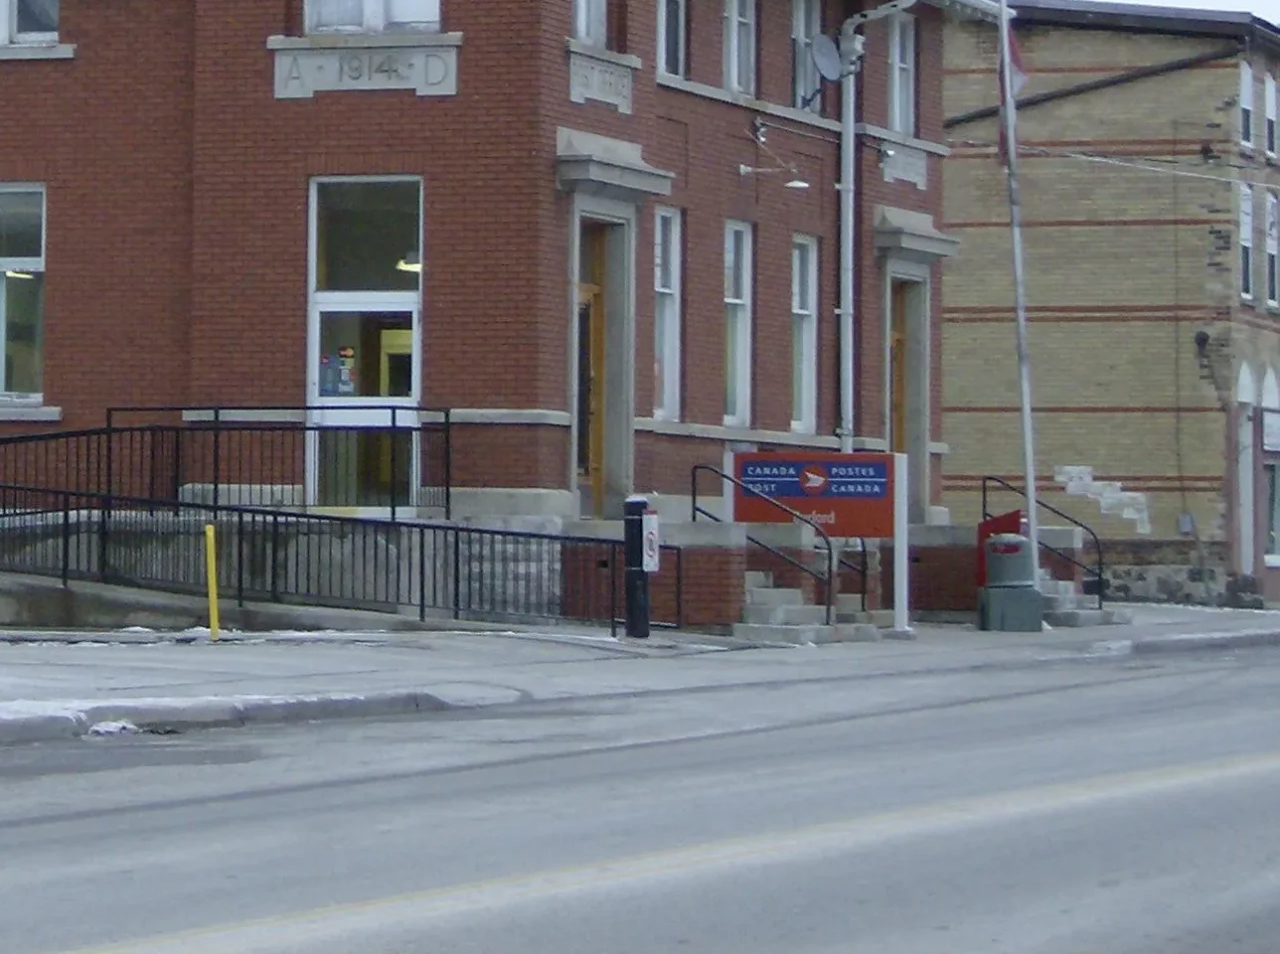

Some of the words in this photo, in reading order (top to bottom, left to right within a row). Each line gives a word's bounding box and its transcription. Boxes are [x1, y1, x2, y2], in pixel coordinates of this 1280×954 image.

[424, 53, 448, 86] D
[746, 466, 797, 476] CANADA
[831, 466, 876, 477] POSTES
[830, 483, 881, 494] CANADA
